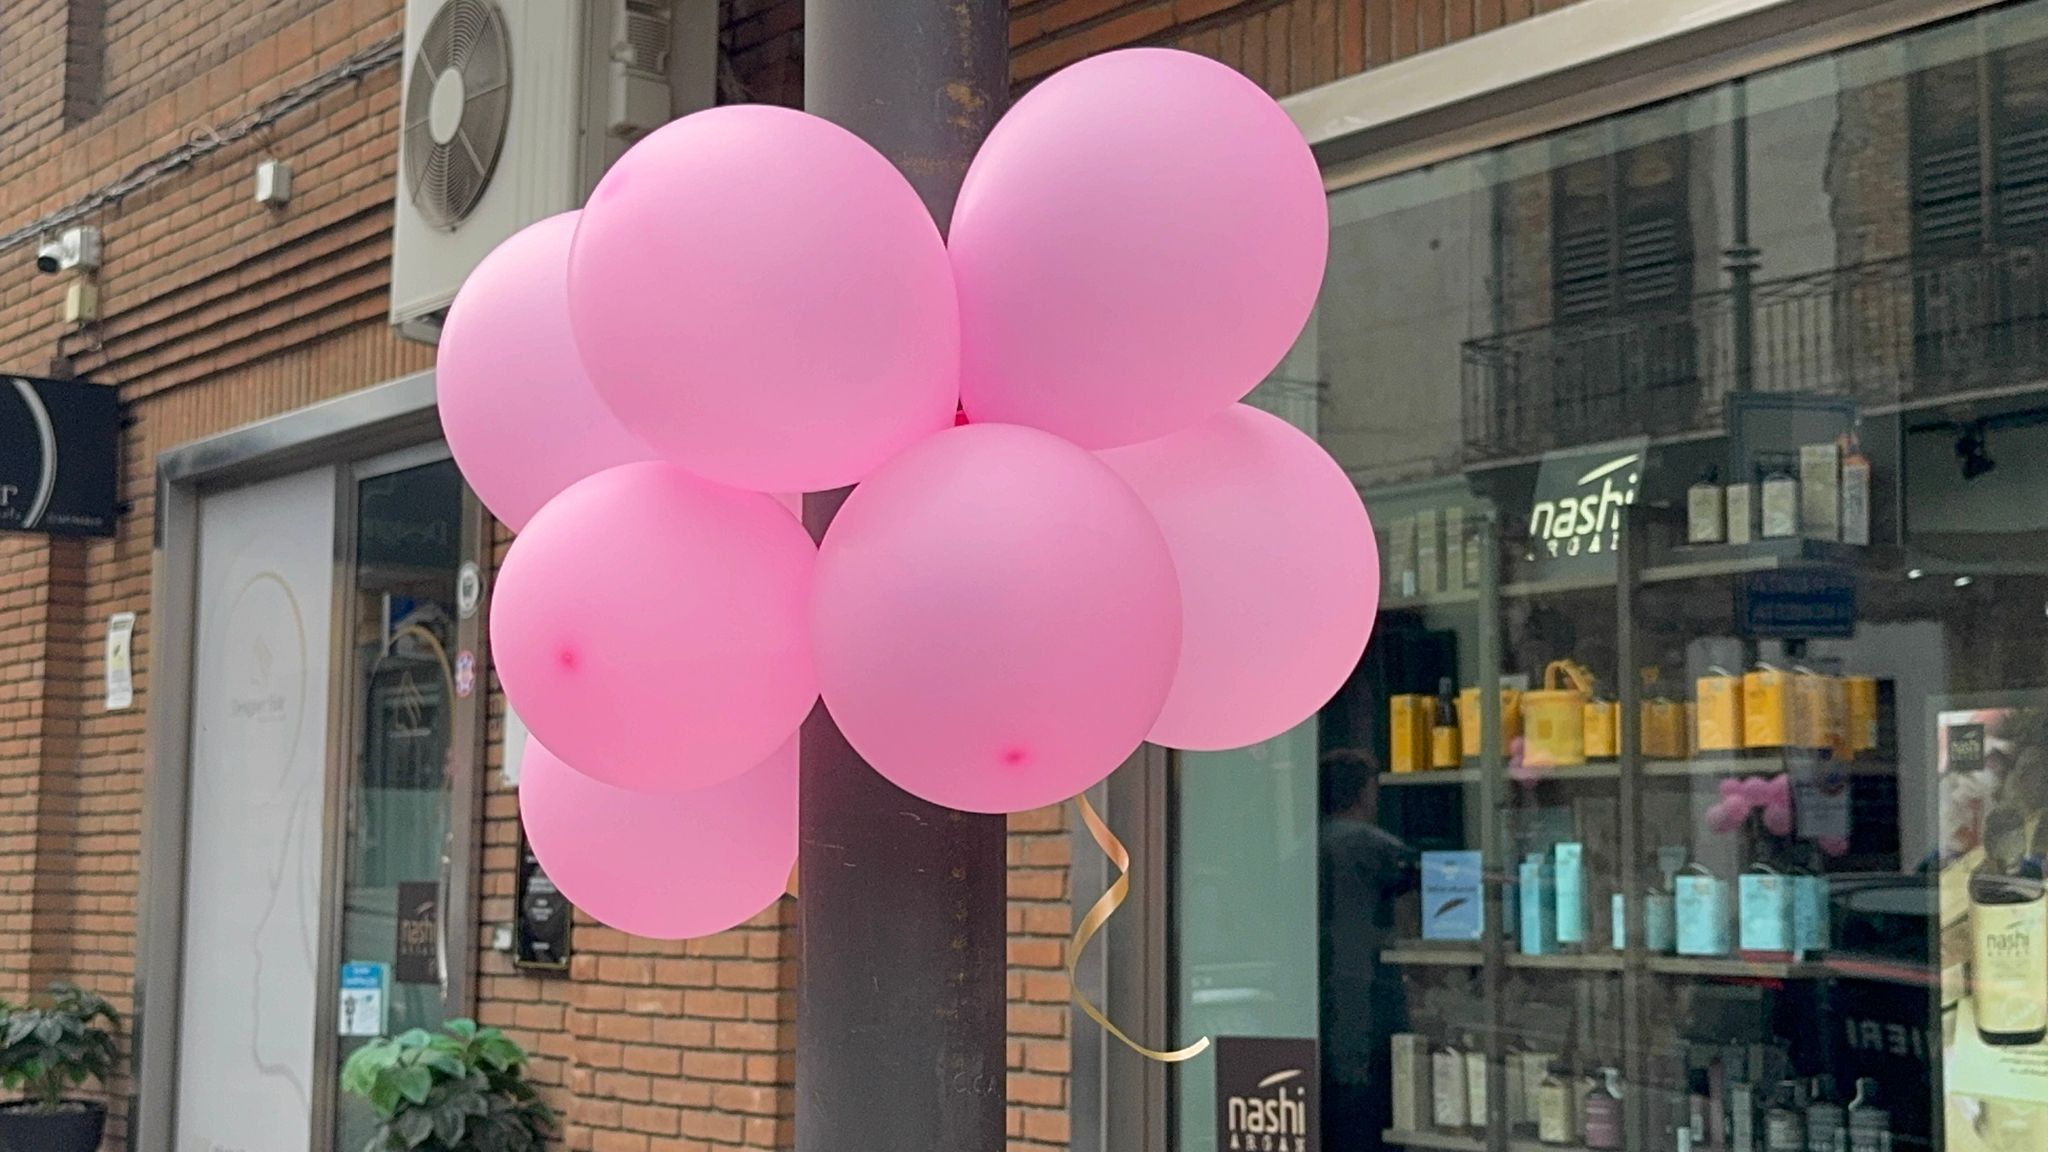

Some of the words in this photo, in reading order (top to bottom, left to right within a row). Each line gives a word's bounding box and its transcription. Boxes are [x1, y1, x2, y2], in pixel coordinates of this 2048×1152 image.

[1529, 472, 1638, 540] nashi
[1986, 931, 2030, 949] nashi
[1228, 1086, 1306, 1135] nashi
